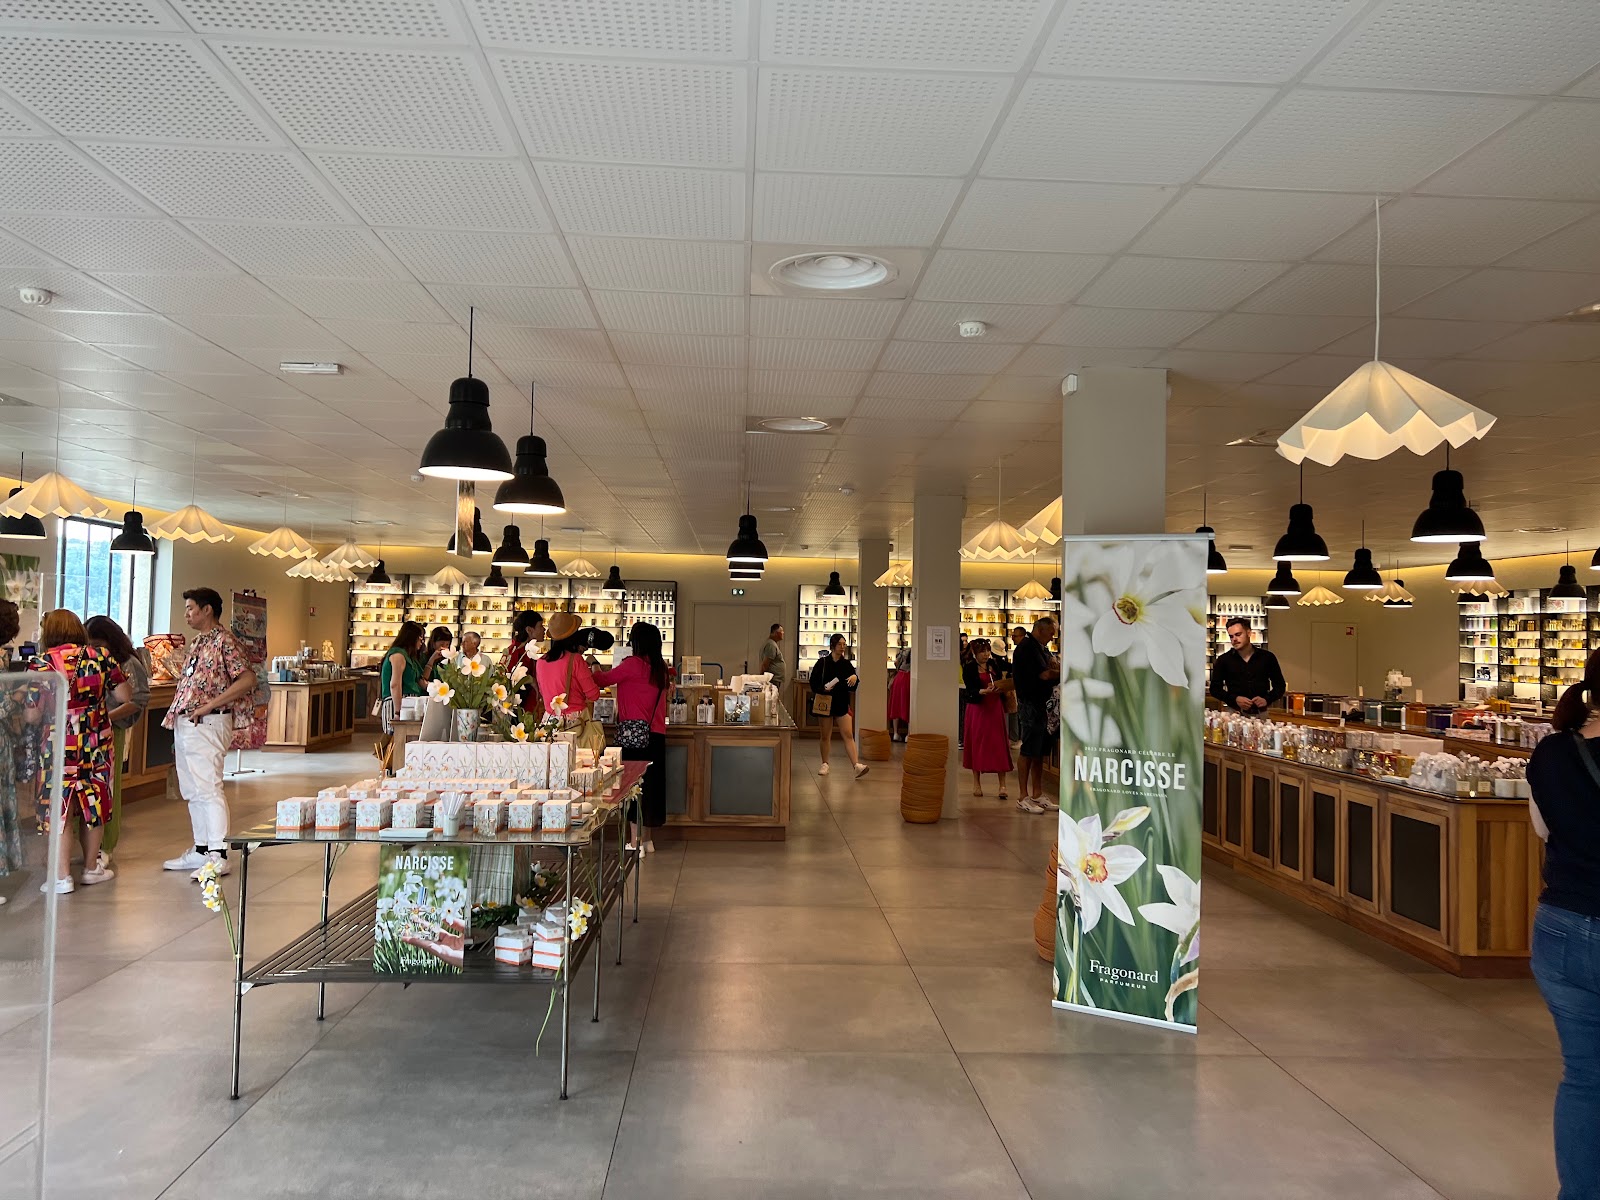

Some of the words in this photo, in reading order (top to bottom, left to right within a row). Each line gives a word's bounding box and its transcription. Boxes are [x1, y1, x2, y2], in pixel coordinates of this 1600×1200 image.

[1098, 747, 1137, 755] FRAGONARD
[1074, 755, 1186, 791] NARCISSE
[395, 855, 454, 871] NARCISSE
[1089, 959, 1159, 984] Fragonard
[1099, 977, 1147, 990] PARFUMEUR
